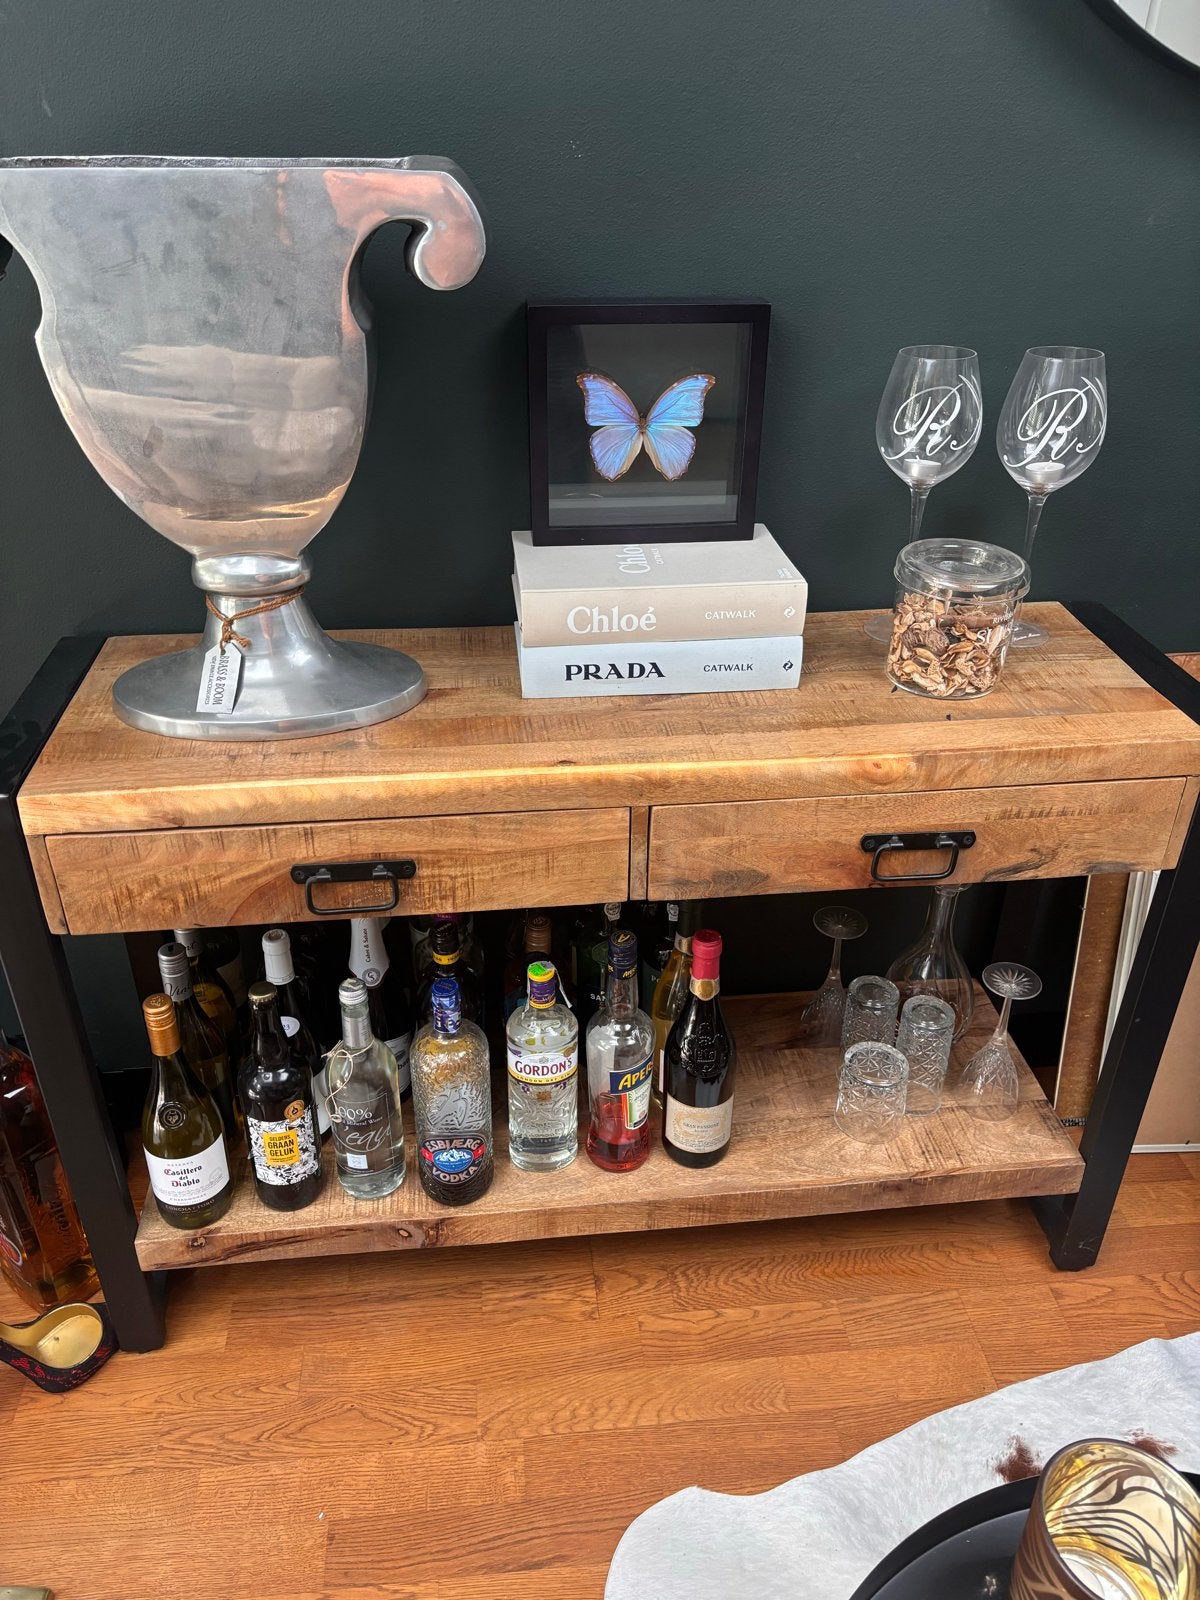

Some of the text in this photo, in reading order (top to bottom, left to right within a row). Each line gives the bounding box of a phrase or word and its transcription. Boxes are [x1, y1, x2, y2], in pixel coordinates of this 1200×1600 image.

[616, 544, 651, 574] Chlo
[566, 606, 757, 635] Chloé CATWALK
[216, 655, 230, 676] BRASS
[564, 662, 754, 682] PRADA CATWALK
[515, 1057, 572, 1076] GORDON'S
[338, 1106, 373, 1120] 00%
[267, 1138, 295, 1149] GRAAN
[269, 1146, 295, 1157] GELUK
[164, 1166, 202, 1176] Casillero
[432, 1166, 478, 1183] VODKA
[171, 1178, 200, 1188] Diablo
